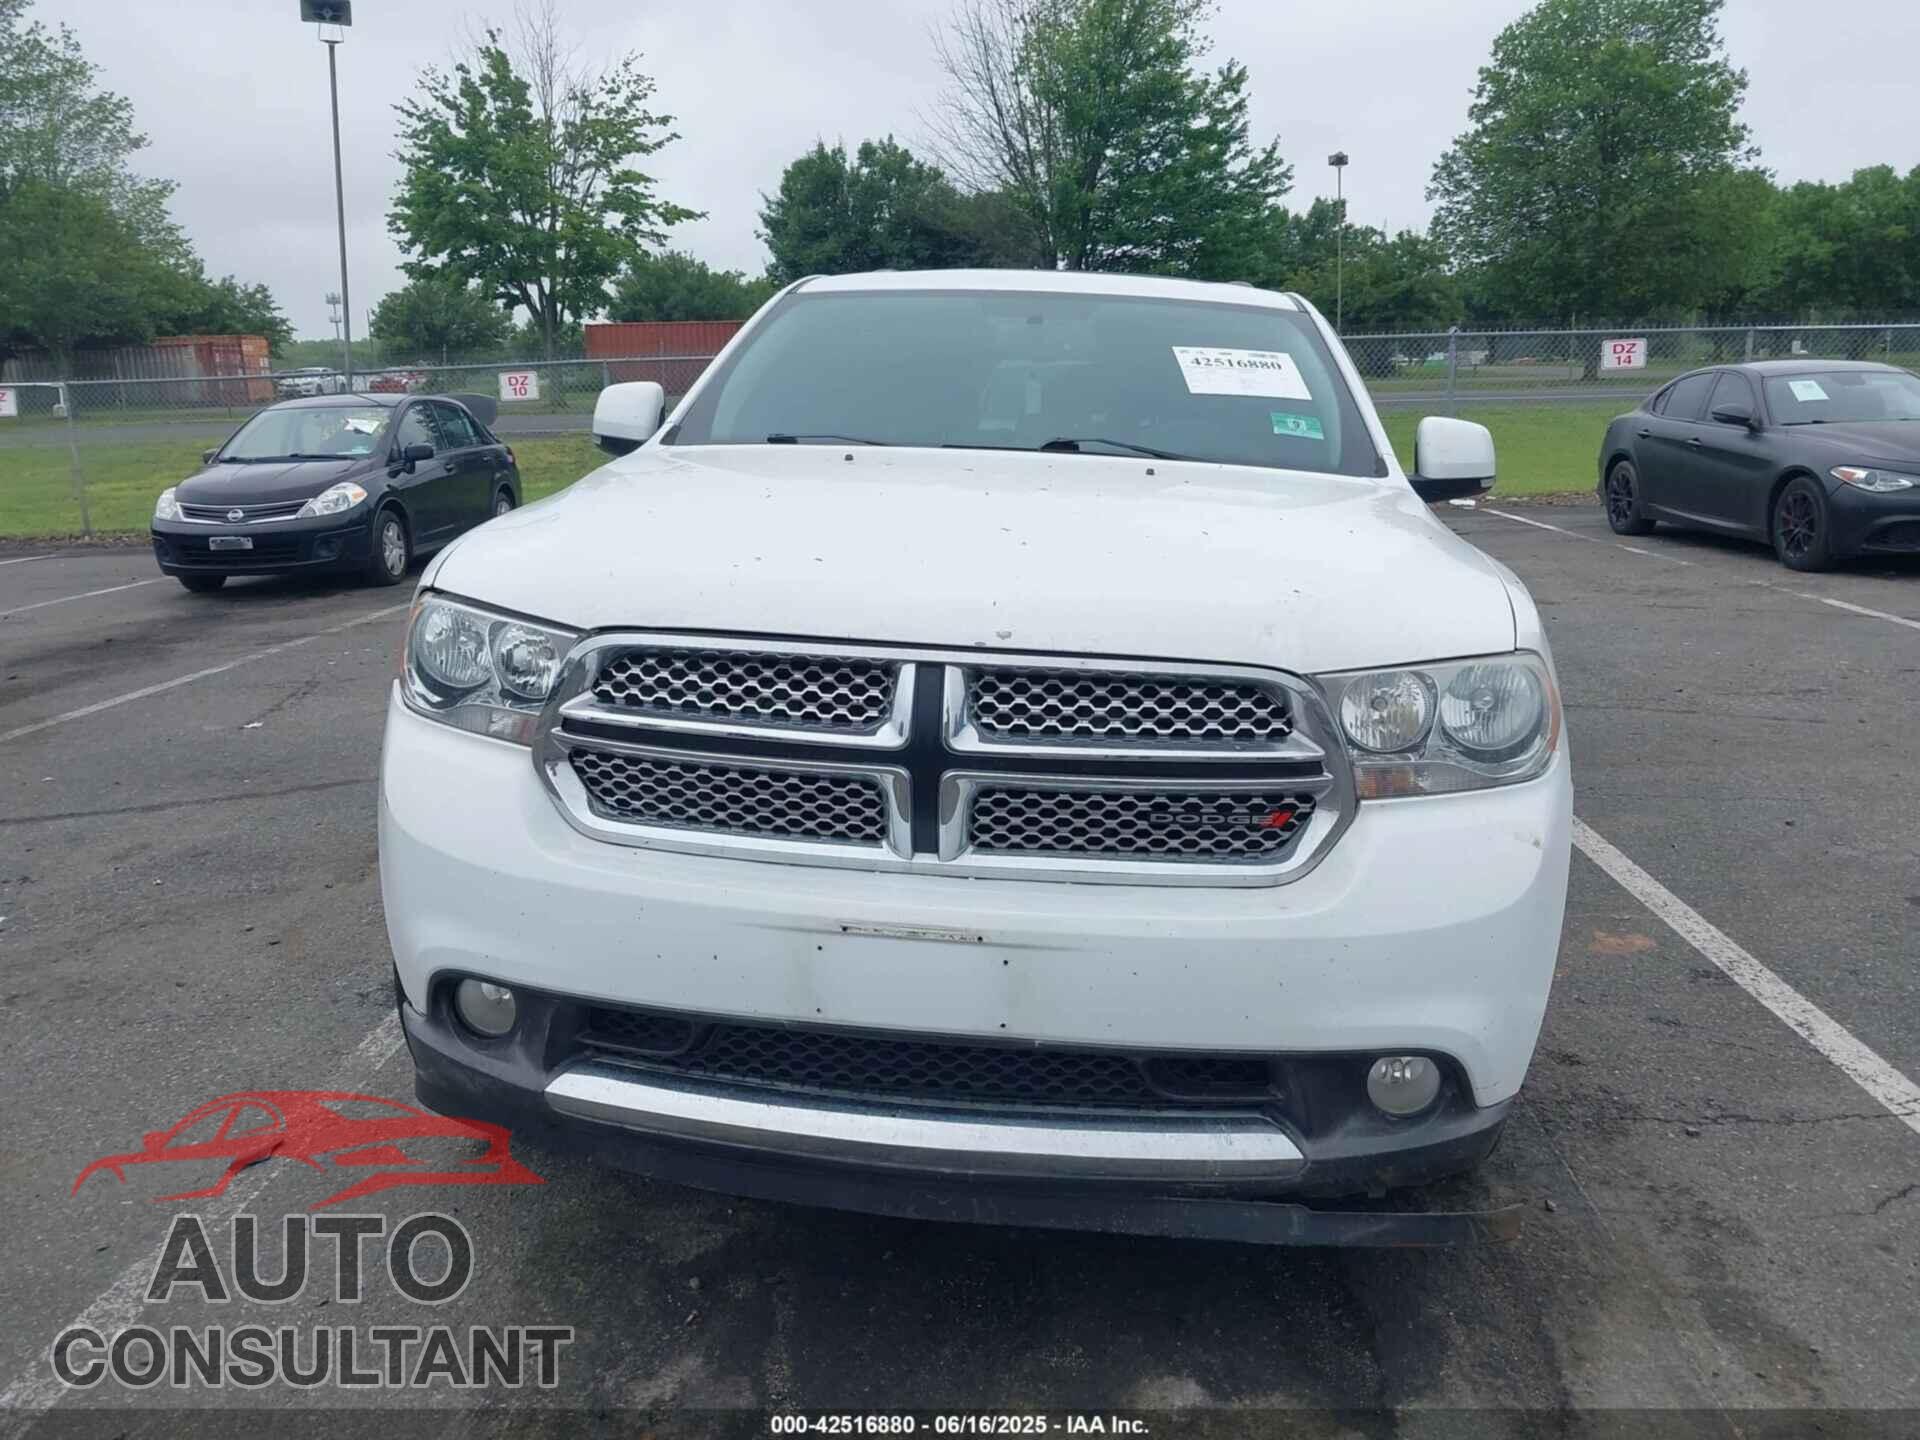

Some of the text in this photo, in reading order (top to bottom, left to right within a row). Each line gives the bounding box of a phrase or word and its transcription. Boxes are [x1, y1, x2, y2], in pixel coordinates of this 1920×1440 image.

[1612, 343, 1637, 354] DZ
[1190, 356, 1283, 371] 42516880
[1615, 355, 1632, 366] 14
[508, 375, 529, 387] DZ
[511, 387, 528, 397] 10
[1150, 813, 1273, 825] DODGE
